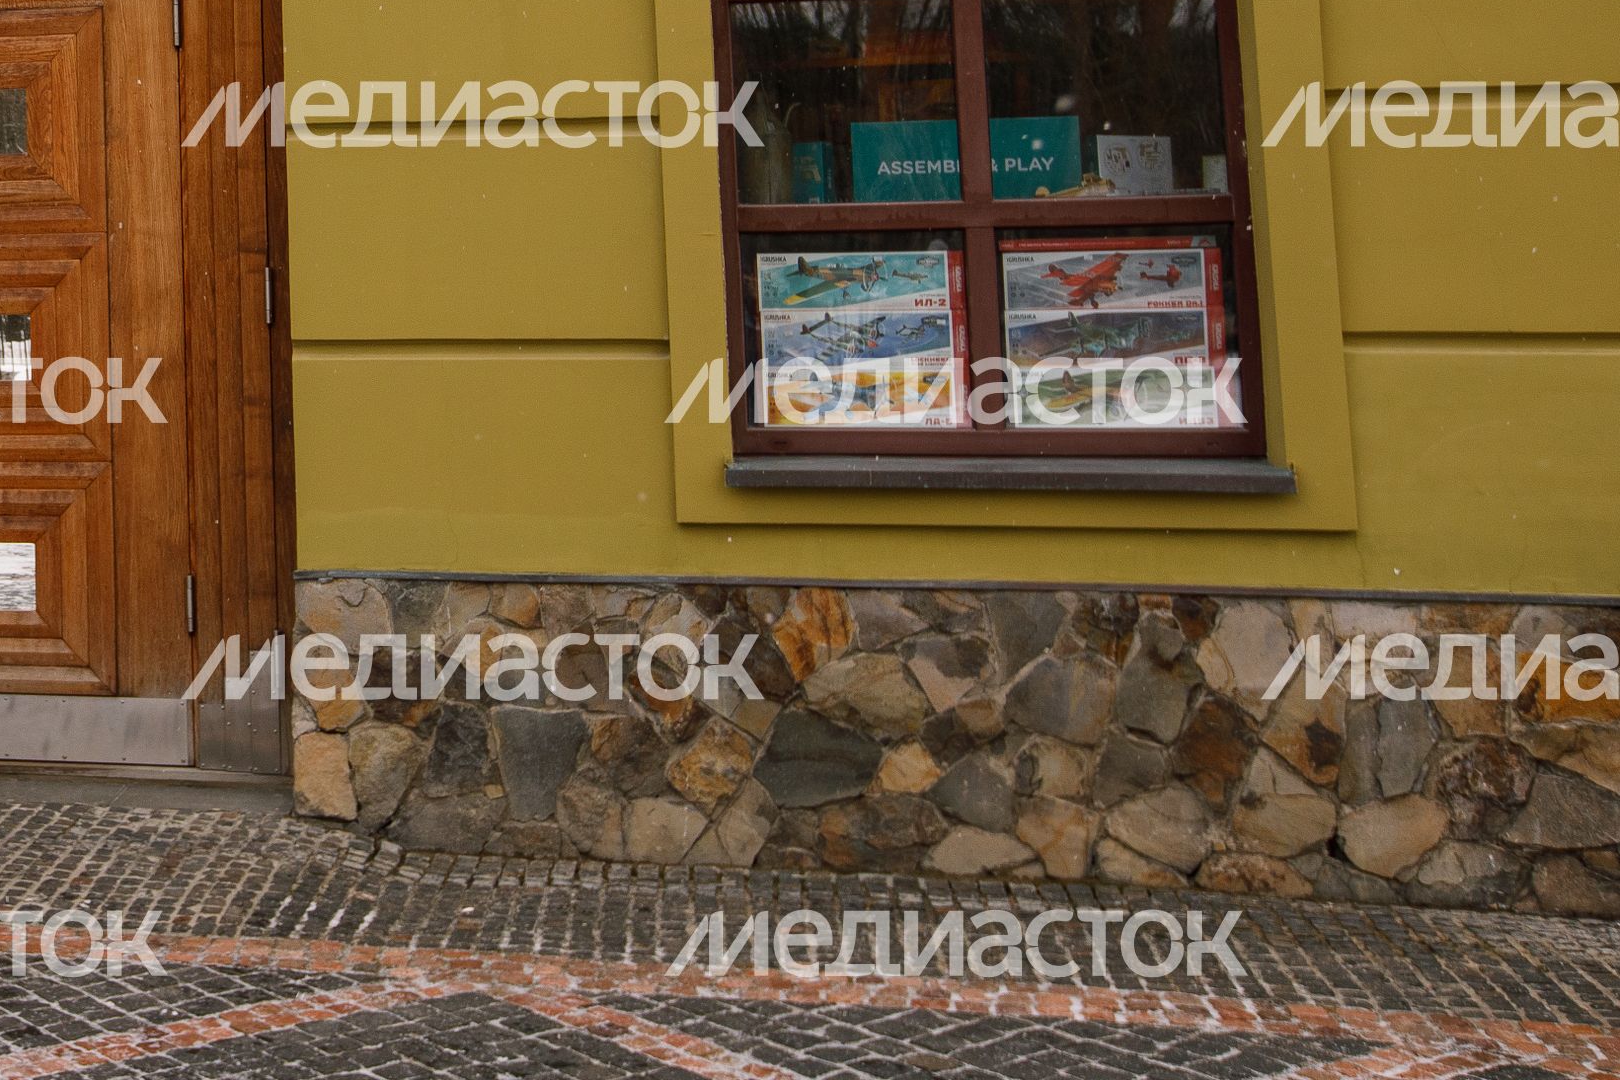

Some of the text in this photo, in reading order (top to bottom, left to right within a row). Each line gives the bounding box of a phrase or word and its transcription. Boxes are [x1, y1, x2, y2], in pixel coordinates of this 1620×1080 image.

[877, 159, 961, 175] ASSEMB
[1005, 157, 1055, 172] PLAY
[914, 298, 947, 308] ИЛ-2
